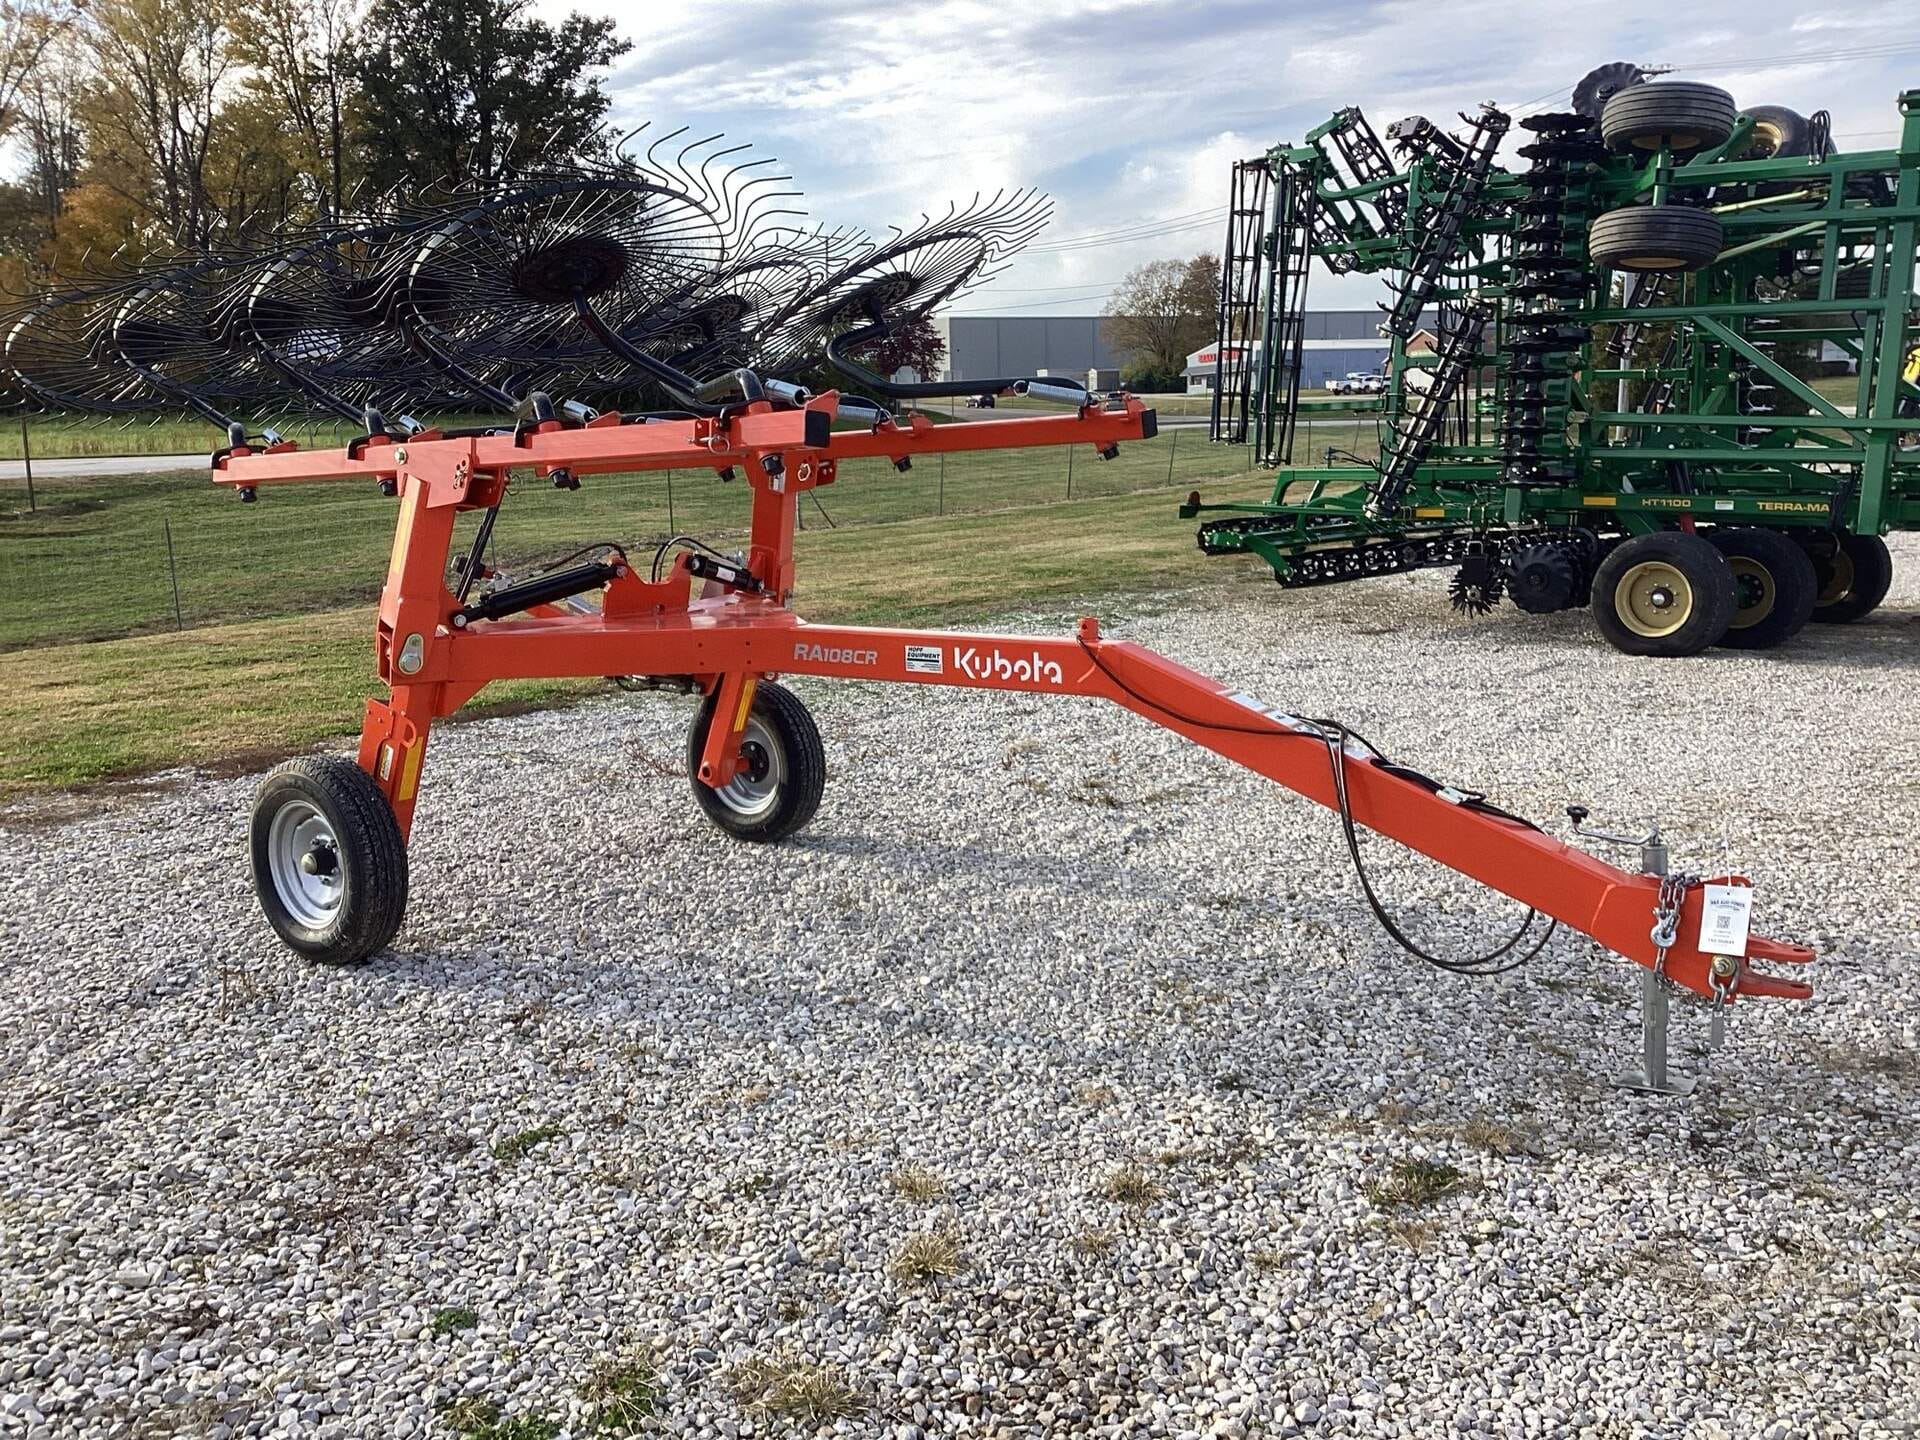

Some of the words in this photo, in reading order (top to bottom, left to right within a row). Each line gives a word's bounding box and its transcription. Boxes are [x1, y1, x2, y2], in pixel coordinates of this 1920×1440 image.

[1642, 498, 1691, 508] HT1100
[1756, 501, 1831, 513] TERRA-MA
[793, 643, 879, 665] RA108CR
[953, 646, 1063, 684] Kubota
